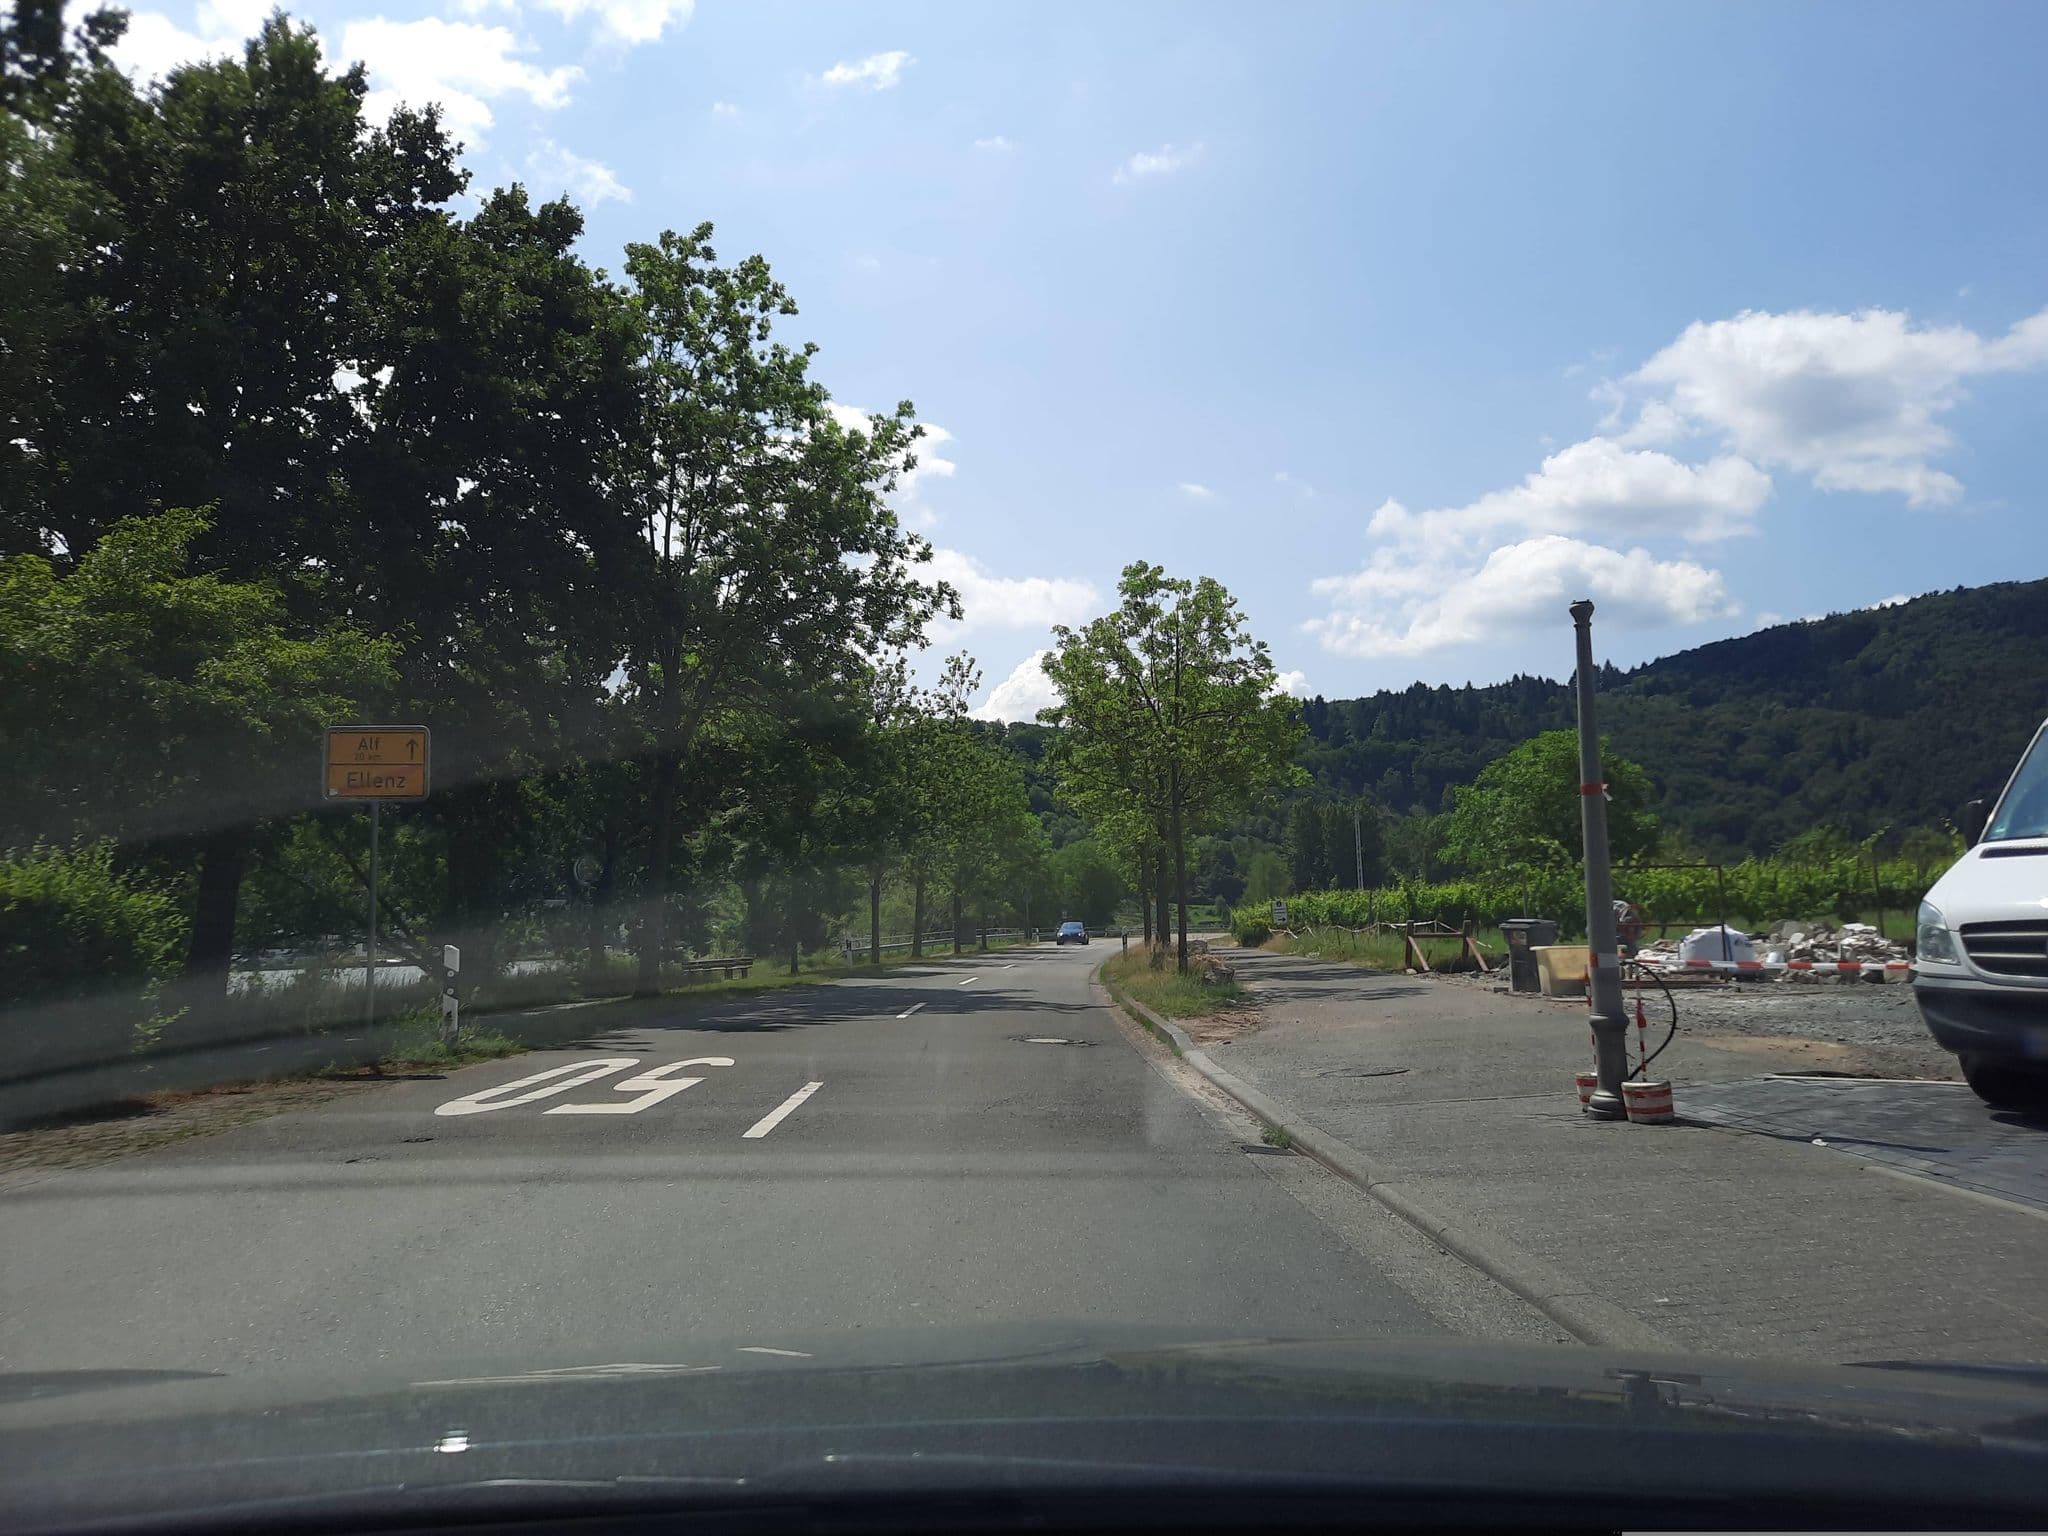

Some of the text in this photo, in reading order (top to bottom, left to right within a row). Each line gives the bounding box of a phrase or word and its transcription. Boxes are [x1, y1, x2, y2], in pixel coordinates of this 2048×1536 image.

[358, 736, 380, 751] Alf
[347, 771, 407, 789] Ellenz
[433, 1057, 735, 1116] 50
